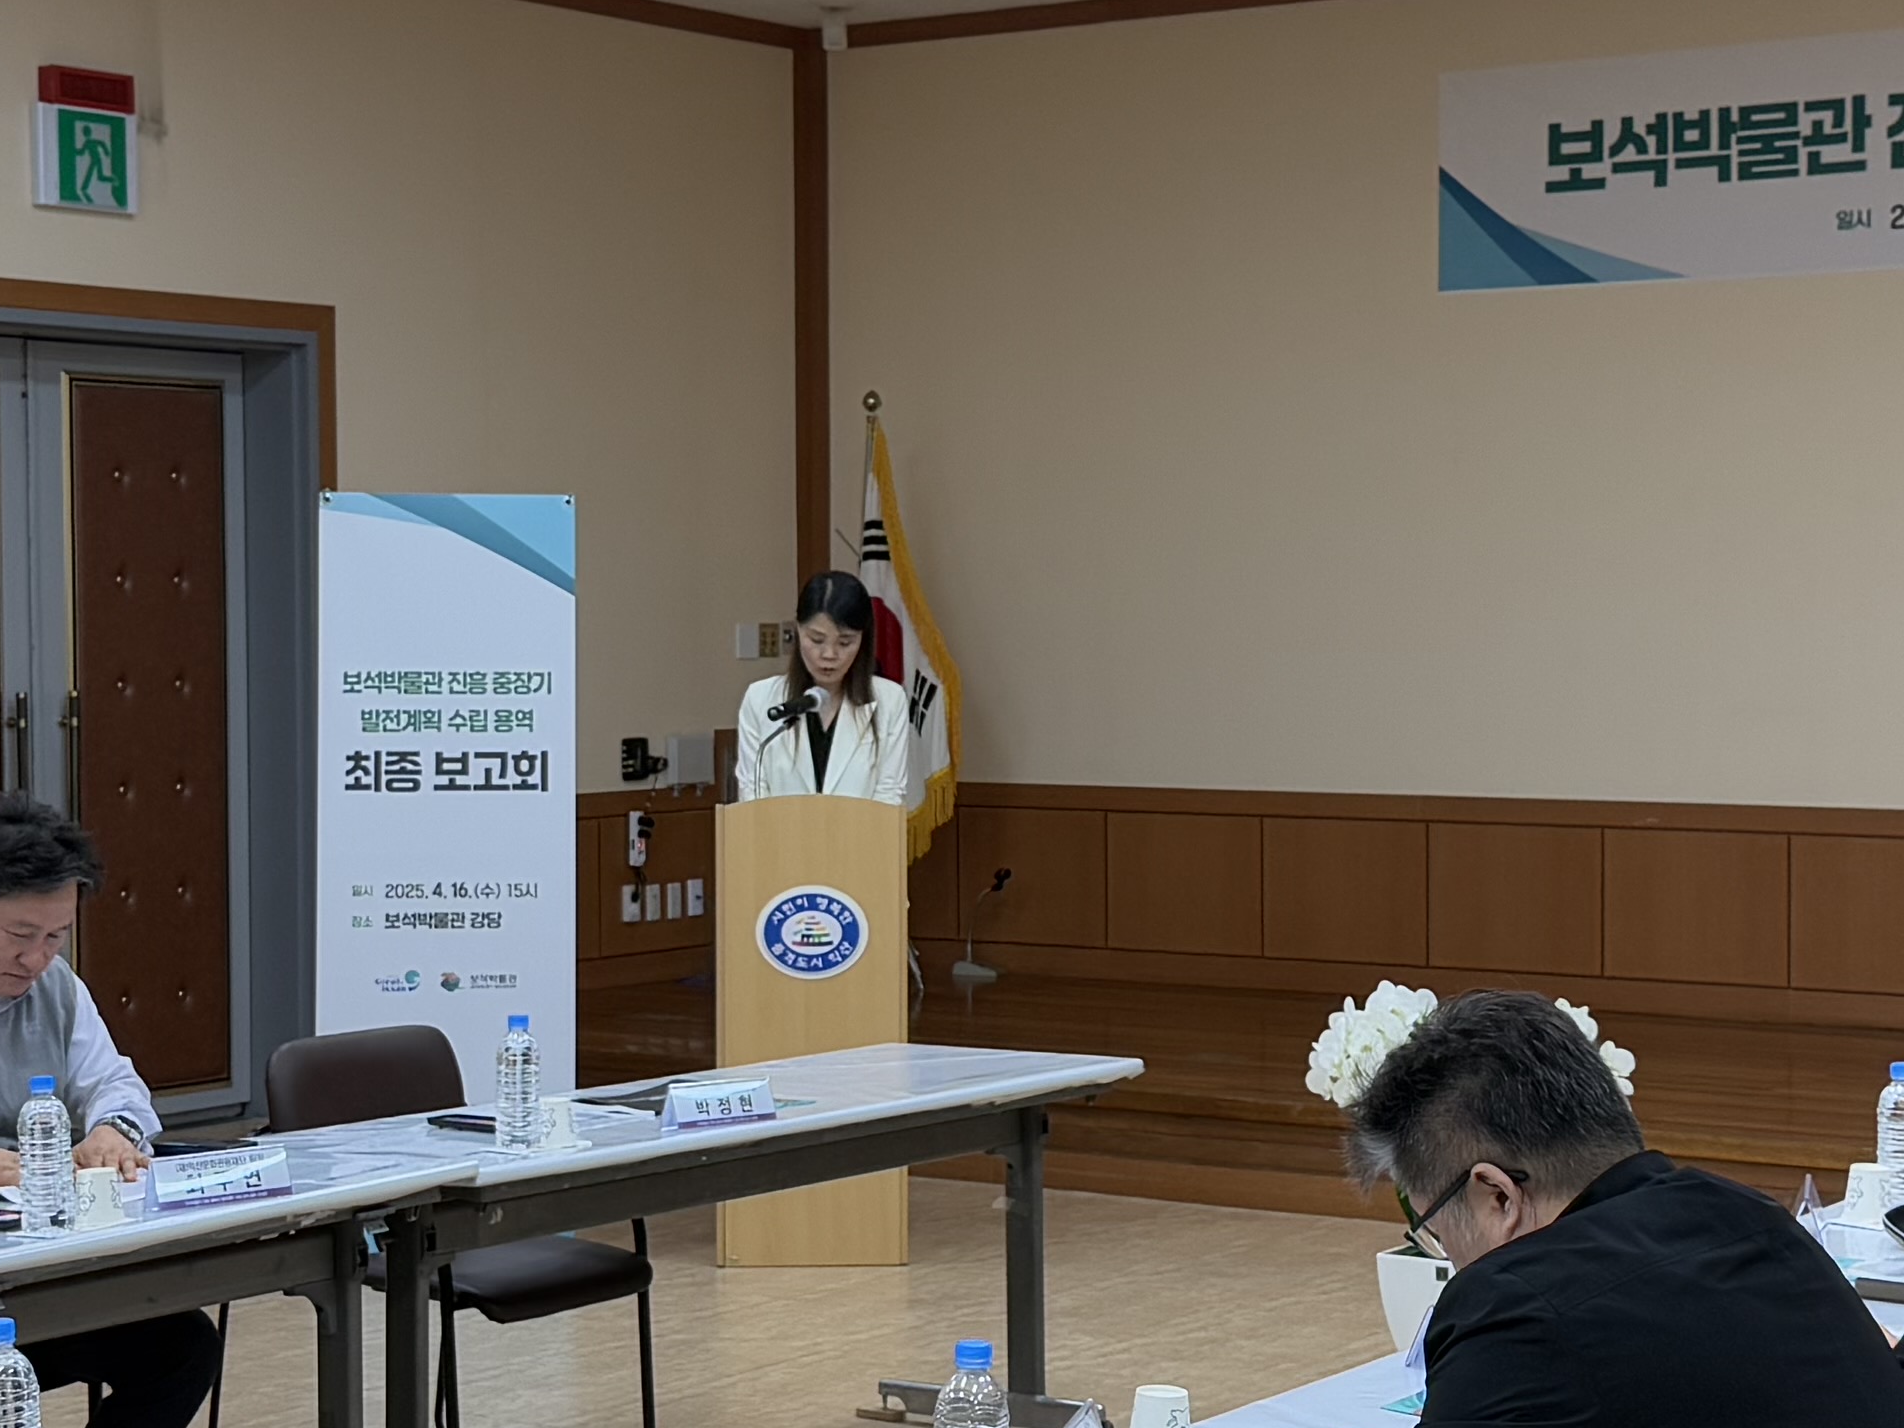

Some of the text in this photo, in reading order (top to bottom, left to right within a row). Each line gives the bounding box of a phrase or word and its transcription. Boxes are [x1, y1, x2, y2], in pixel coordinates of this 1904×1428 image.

[1544, 92, 1873, 194] 보석박물관
[1835, 208, 1872, 231] 일시
[342, 670, 552, 695] 보석박물관 진흥 중장기
[360, 708, 534, 733] 발전계획 수립 용역
[344, 750, 549, 793] 최종 보고회
[384, 883, 429, 899] 2025.
[431, 882, 447, 899] 4.
[507, 882, 538, 899] 15시
[384, 911, 466, 930] 보석박물관
[470, 911, 503, 929] 강당
